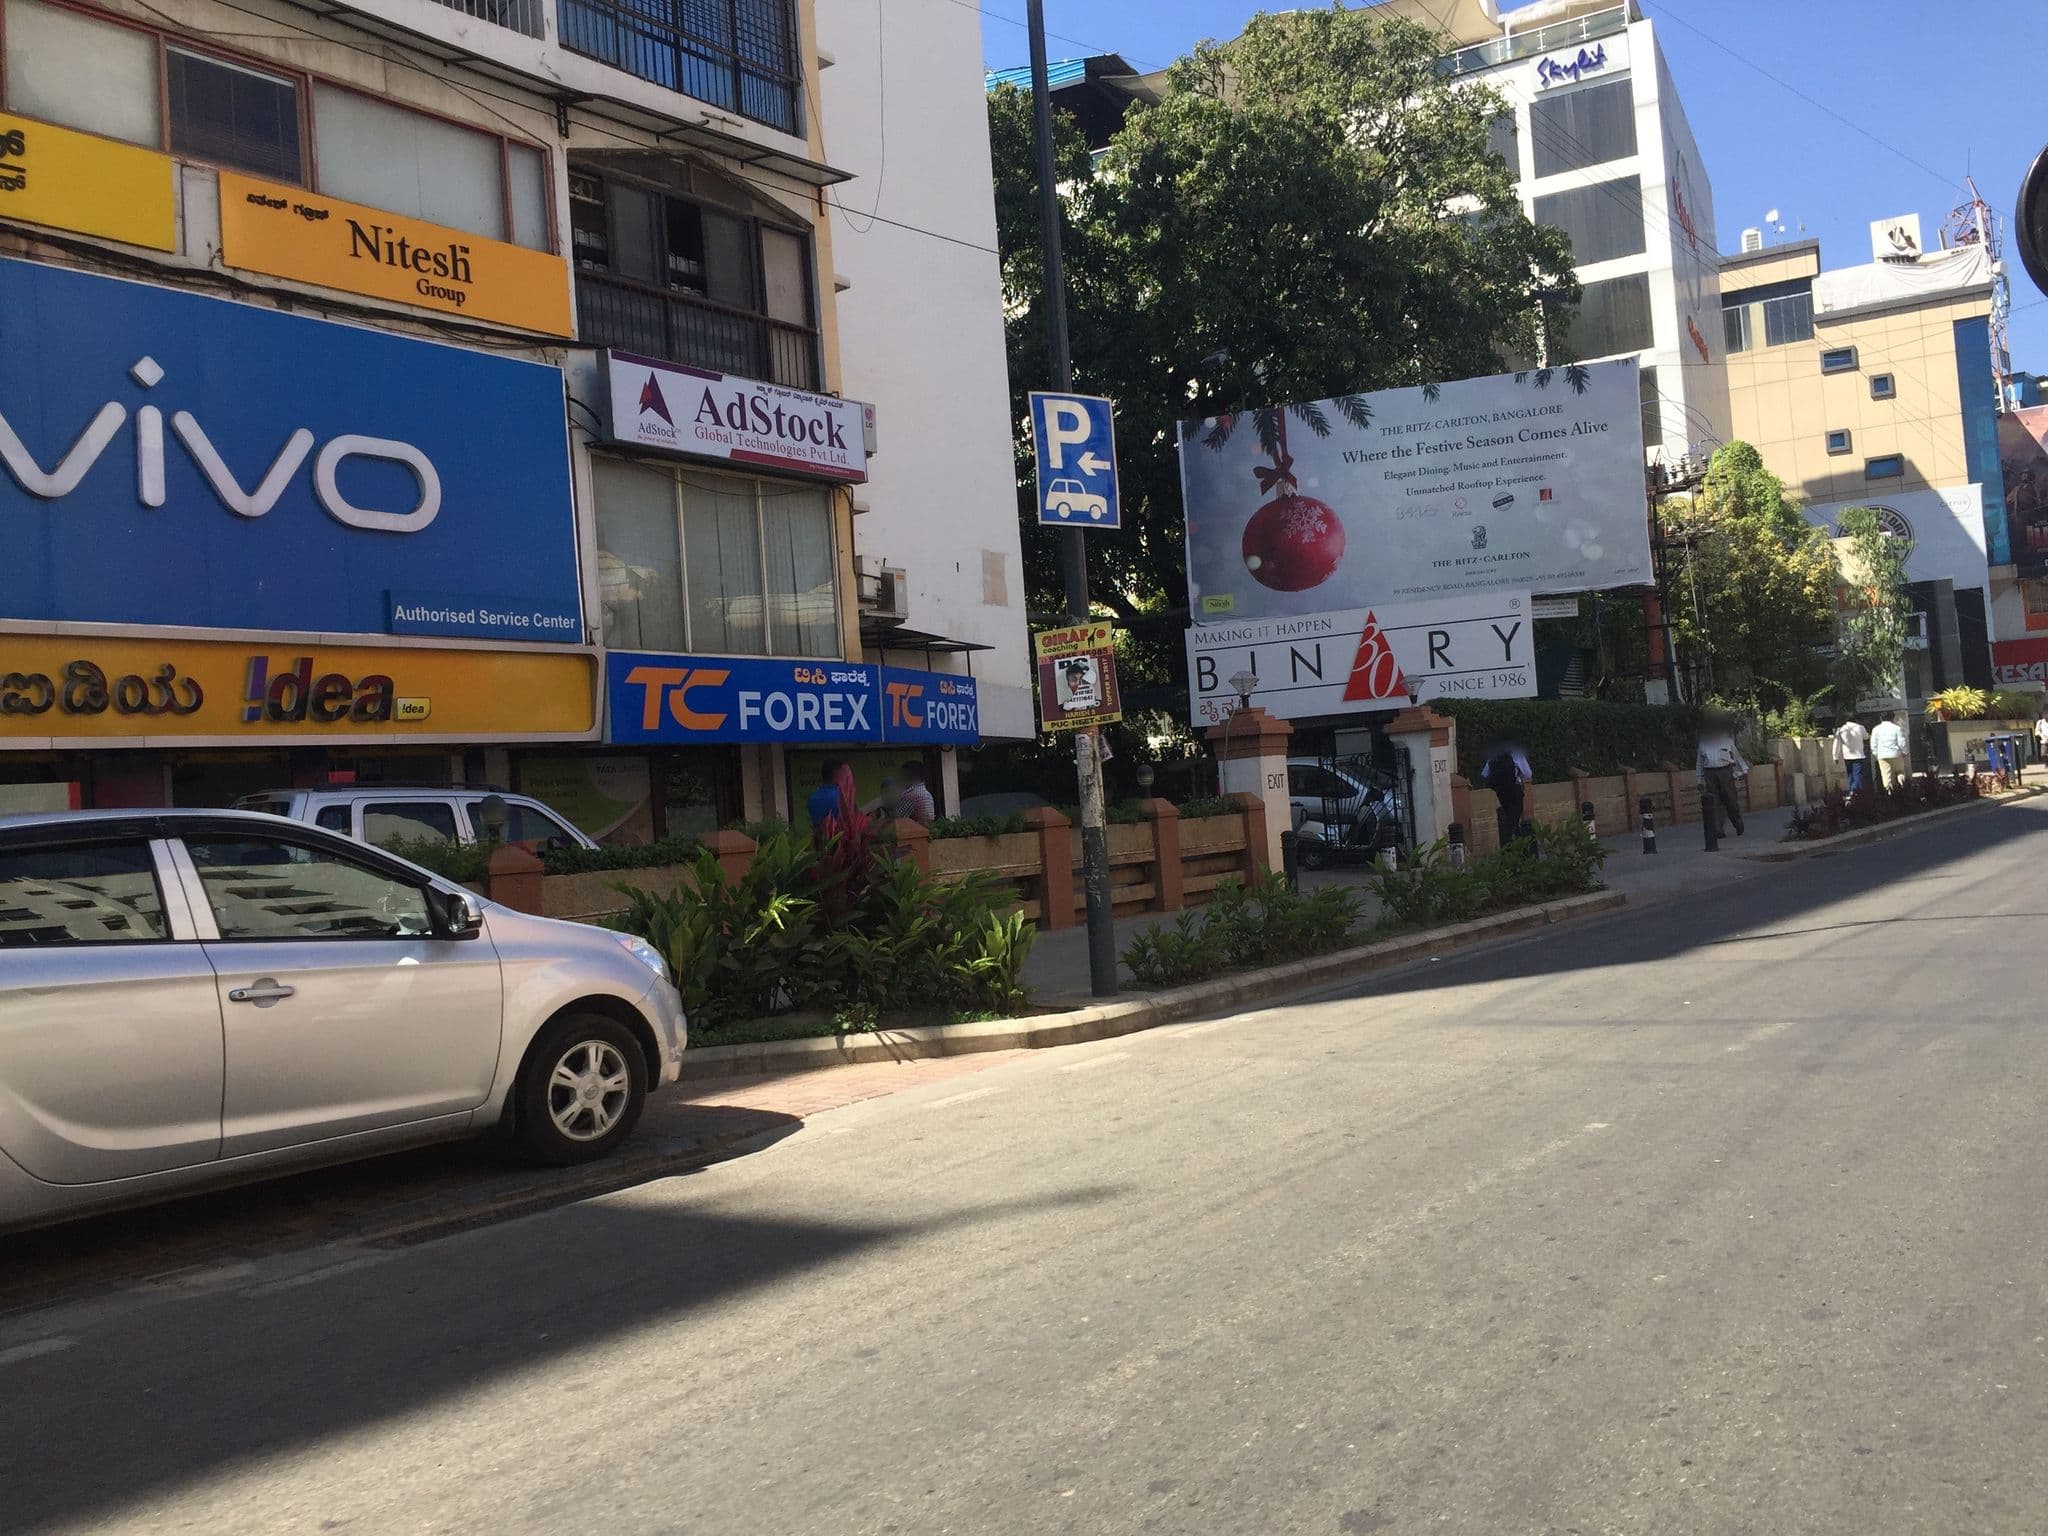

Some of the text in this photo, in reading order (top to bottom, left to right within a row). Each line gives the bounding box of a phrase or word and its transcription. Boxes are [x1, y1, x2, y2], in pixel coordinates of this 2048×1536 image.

[346, 218, 473, 284] Nitesh
[416, 278, 466, 306] Group
[639, 422, 677, 439] AdStock
[694, 386, 848, 450] AdStock
[864, 421, 874, 430] LG
[1380, 404, 1564, 437] THE RITZ-CARLTON, BANGALORE
[0, 356, 441, 533] vivo
[694, 426, 733, 445] Global
[736, 433, 807, 458] Technologies
[810, 447, 828, 461] Pvt
[1043, 399, 1091, 469] P
[1342, 420, 1609, 465] Where the Festive Season Comes Alive
[1384, 468, 1417, 482] Elegant
[1453, 460, 1480, 472] Music
[1482, 458, 1498, 469] and
[1406, 482, 1456, 497] Unmatched
[1458, 477, 1494, 492] Rooftop
[1432, 558, 1452, 568] THE
[395, 605, 576, 630] Authorised Service Center
[1195, 618, 1332, 645] MAKING IT HAPPEN
[1043, 643, 1079, 655] coaching
[1439, 673, 1526, 693] SINCE 1986
[624, 666, 871, 732] TC FOREX
[886, 681, 977, 731] TC FOREX
[1051, 719, 1069, 729] PUC
[1435, 760, 1447, 772] EXIT
[1268, 774, 1284, 789] EXIT
